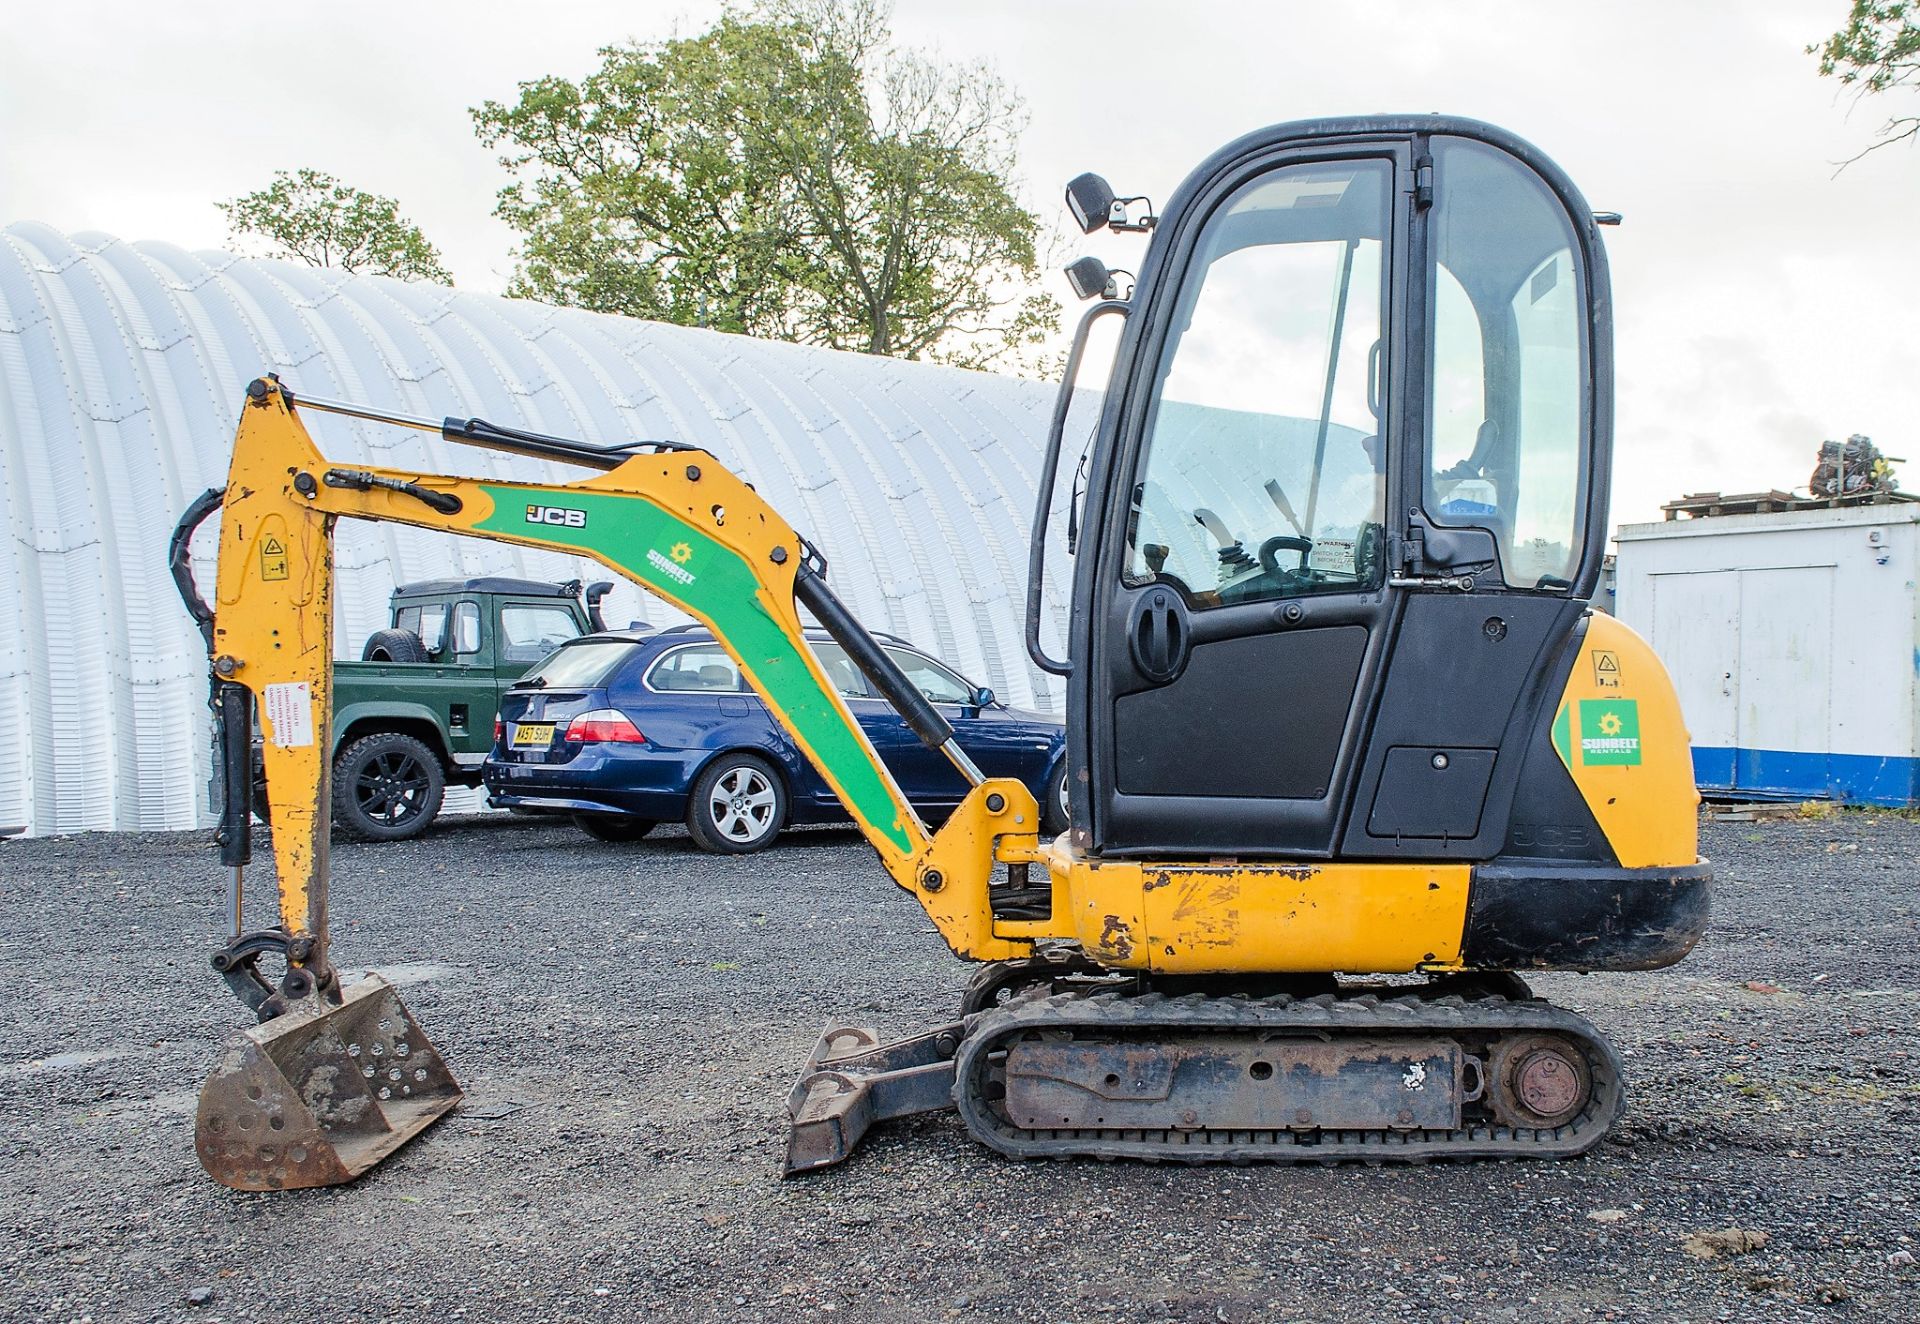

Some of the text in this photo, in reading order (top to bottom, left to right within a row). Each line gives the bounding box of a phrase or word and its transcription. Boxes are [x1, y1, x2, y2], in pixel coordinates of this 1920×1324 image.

[526, 505, 586, 527] JCB
[646, 549, 696, 584] SUNBELT
[1582, 738, 1638, 749] SUNBELT
[1514, 823, 1590, 848] JCB
